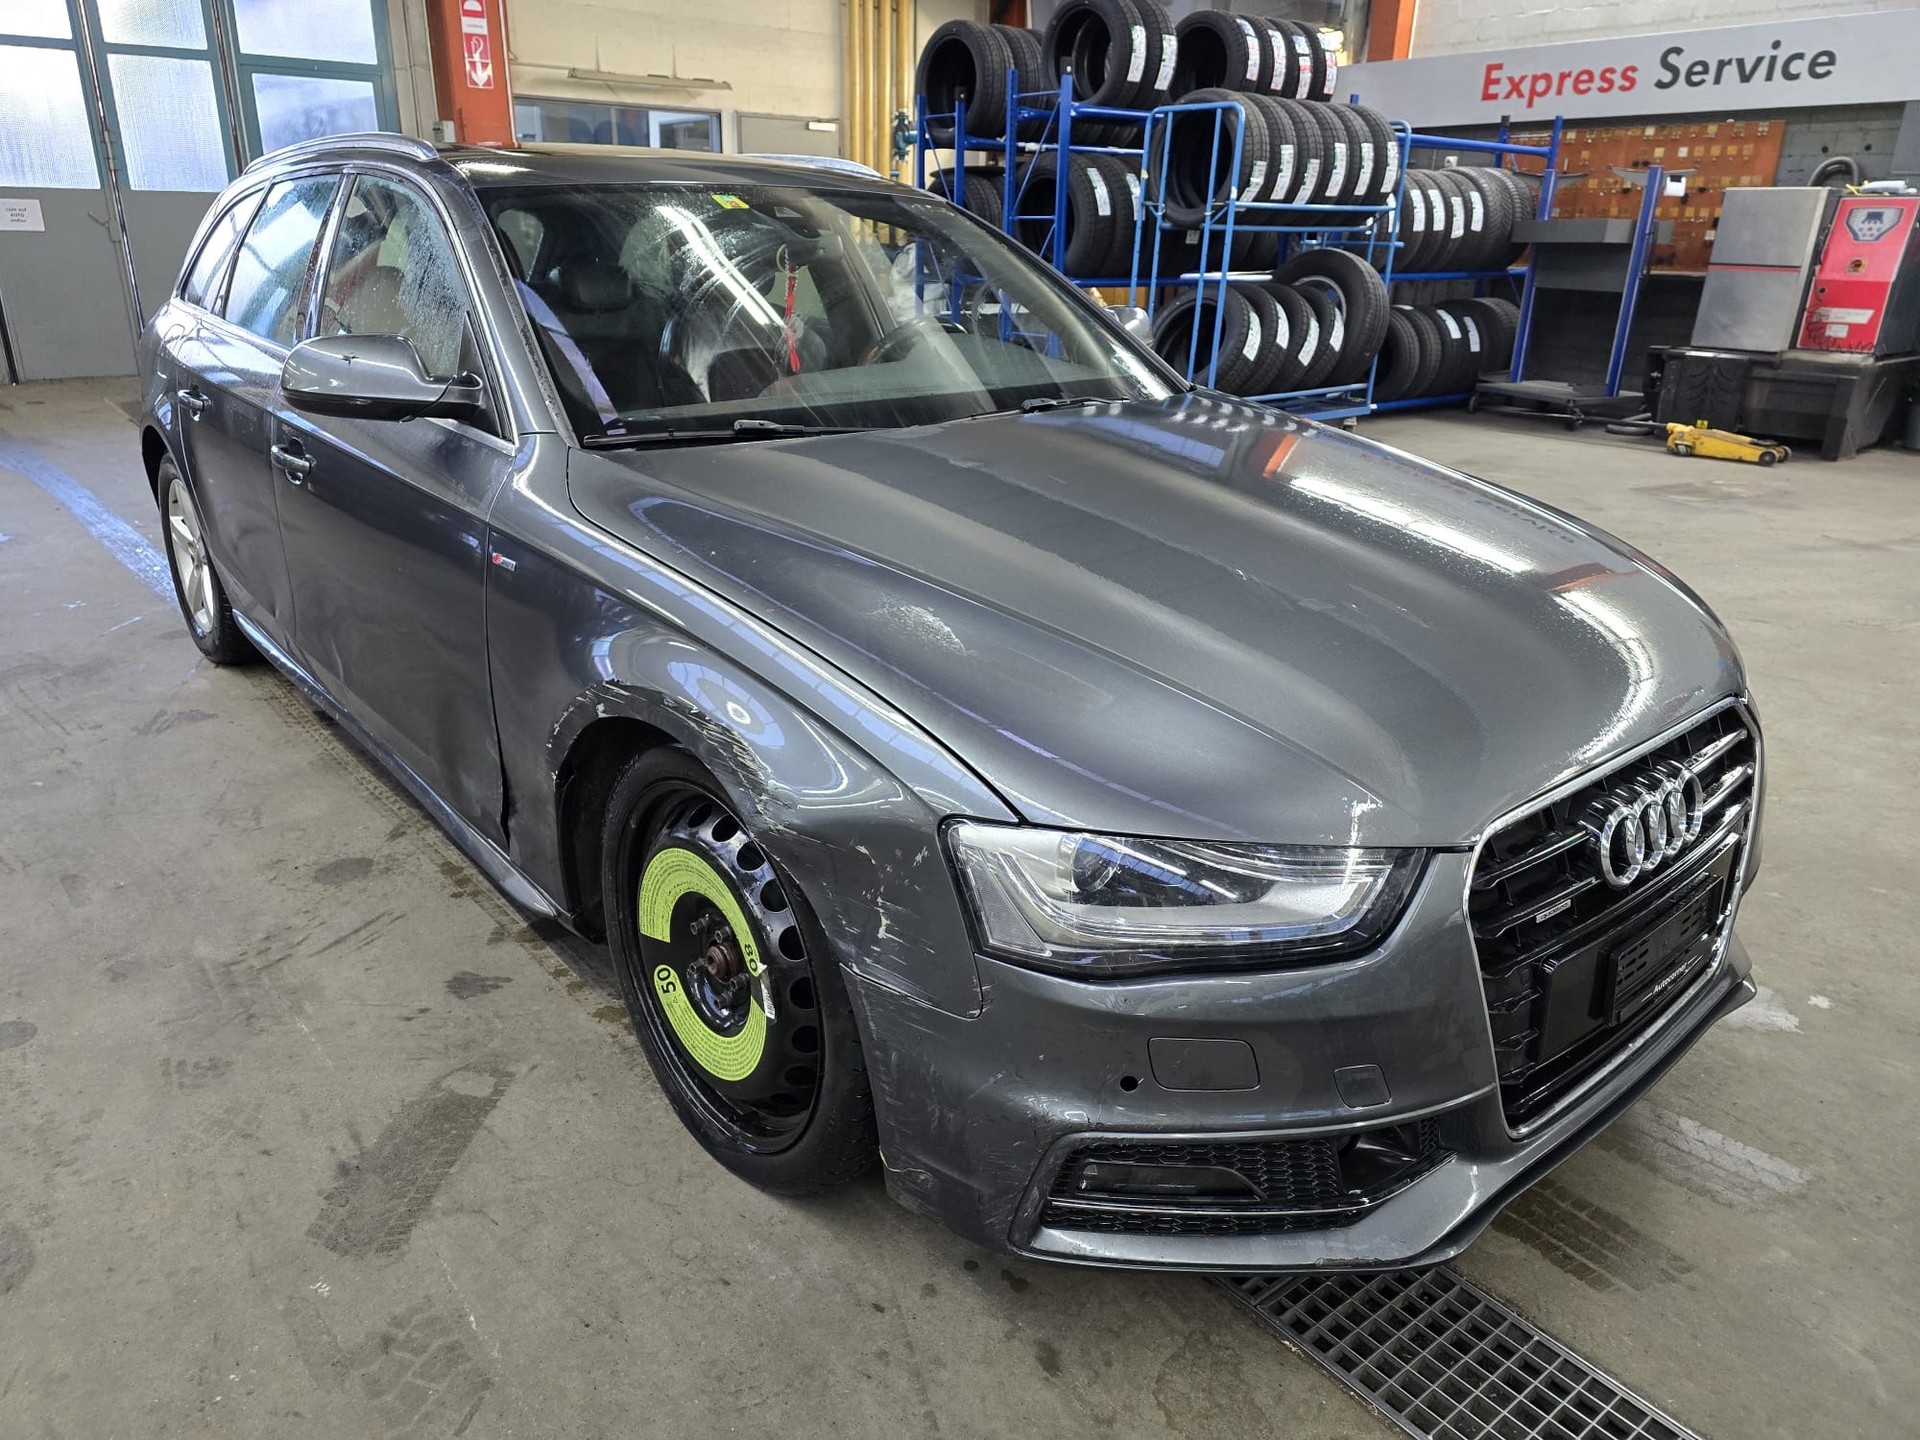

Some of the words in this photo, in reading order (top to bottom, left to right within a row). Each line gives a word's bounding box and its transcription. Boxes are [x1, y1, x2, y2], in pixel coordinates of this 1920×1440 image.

[1480, 62, 1639, 109] Express
[1653, 39, 1838, 90] Service
[657, 967, 677, 994] 50
